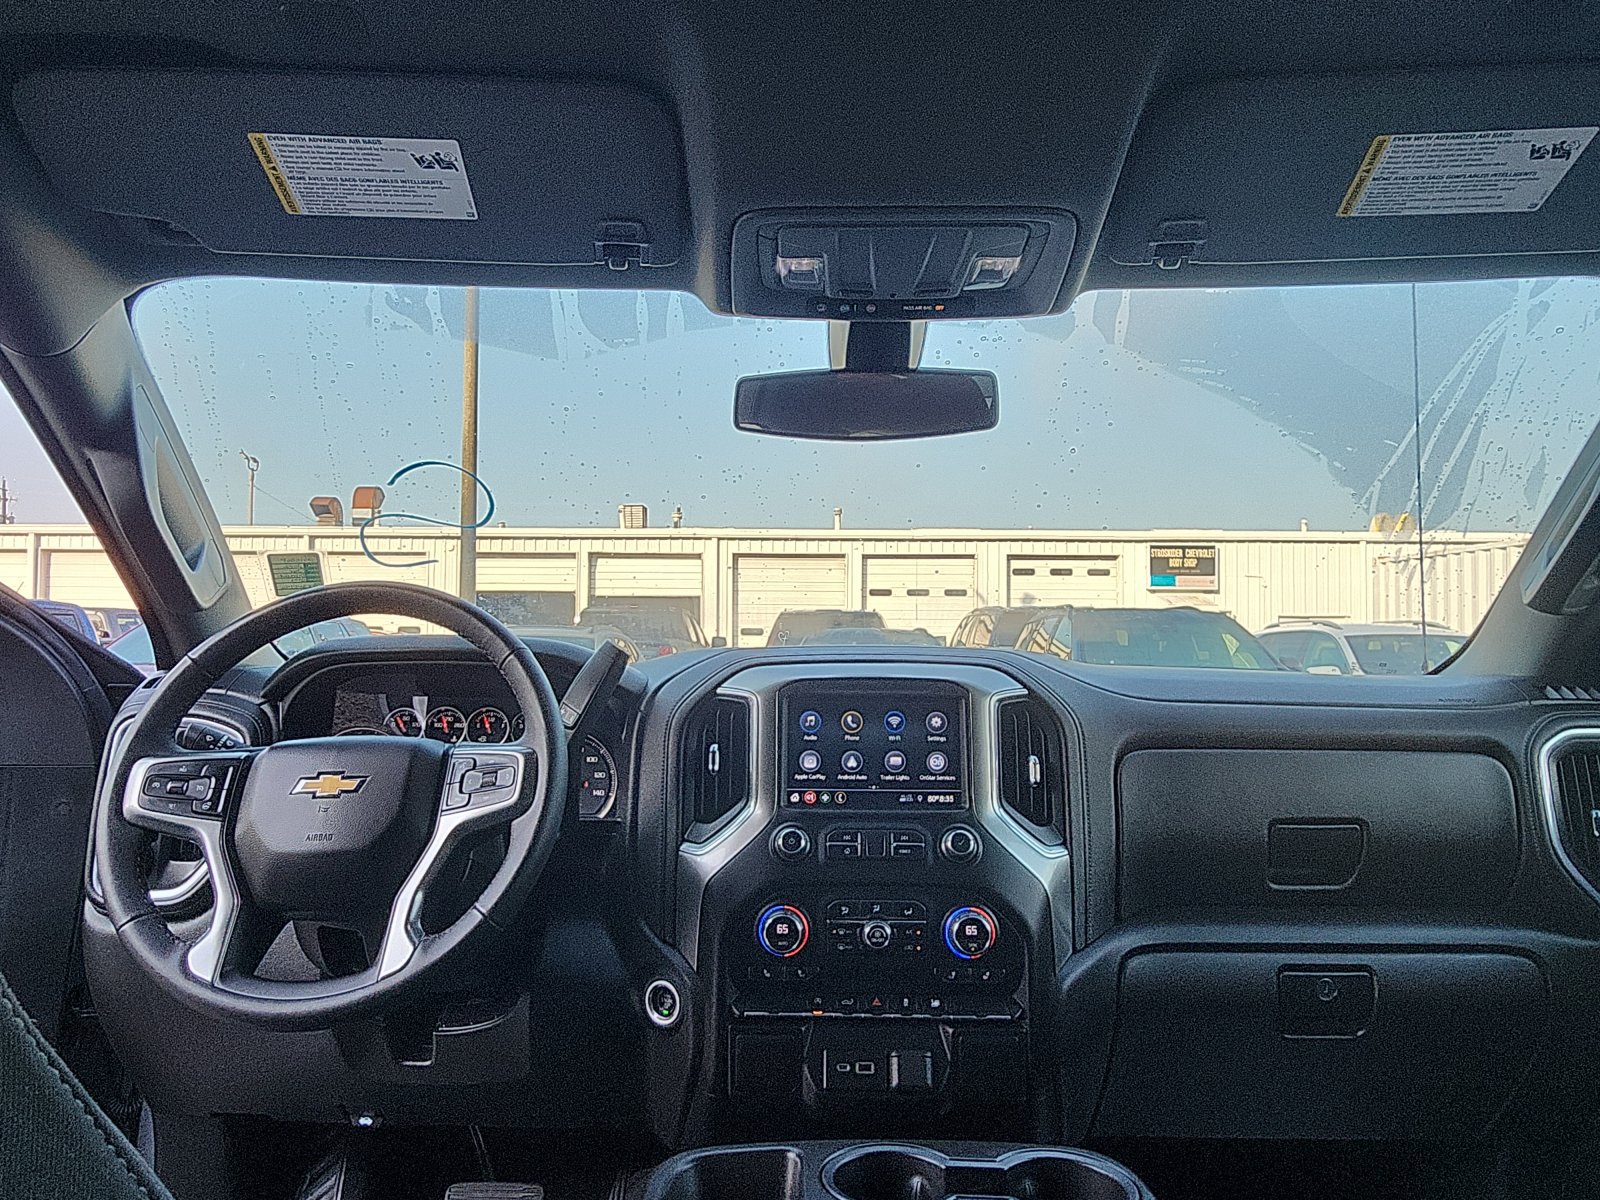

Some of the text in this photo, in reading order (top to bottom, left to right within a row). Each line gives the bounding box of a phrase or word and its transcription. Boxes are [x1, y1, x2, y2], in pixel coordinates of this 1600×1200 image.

[1434, 133, 1476, 141] ADVANCED
[1185, 549, 1215, 558] CHEVROLET
[594, 771, 606, 779] 120
[809, 773, 826, 781] CarPlay
[304, 833, 334, 842] AIRBAG
[776, 923, 789, 935] 65
[965, 925, 978, 936] 65
